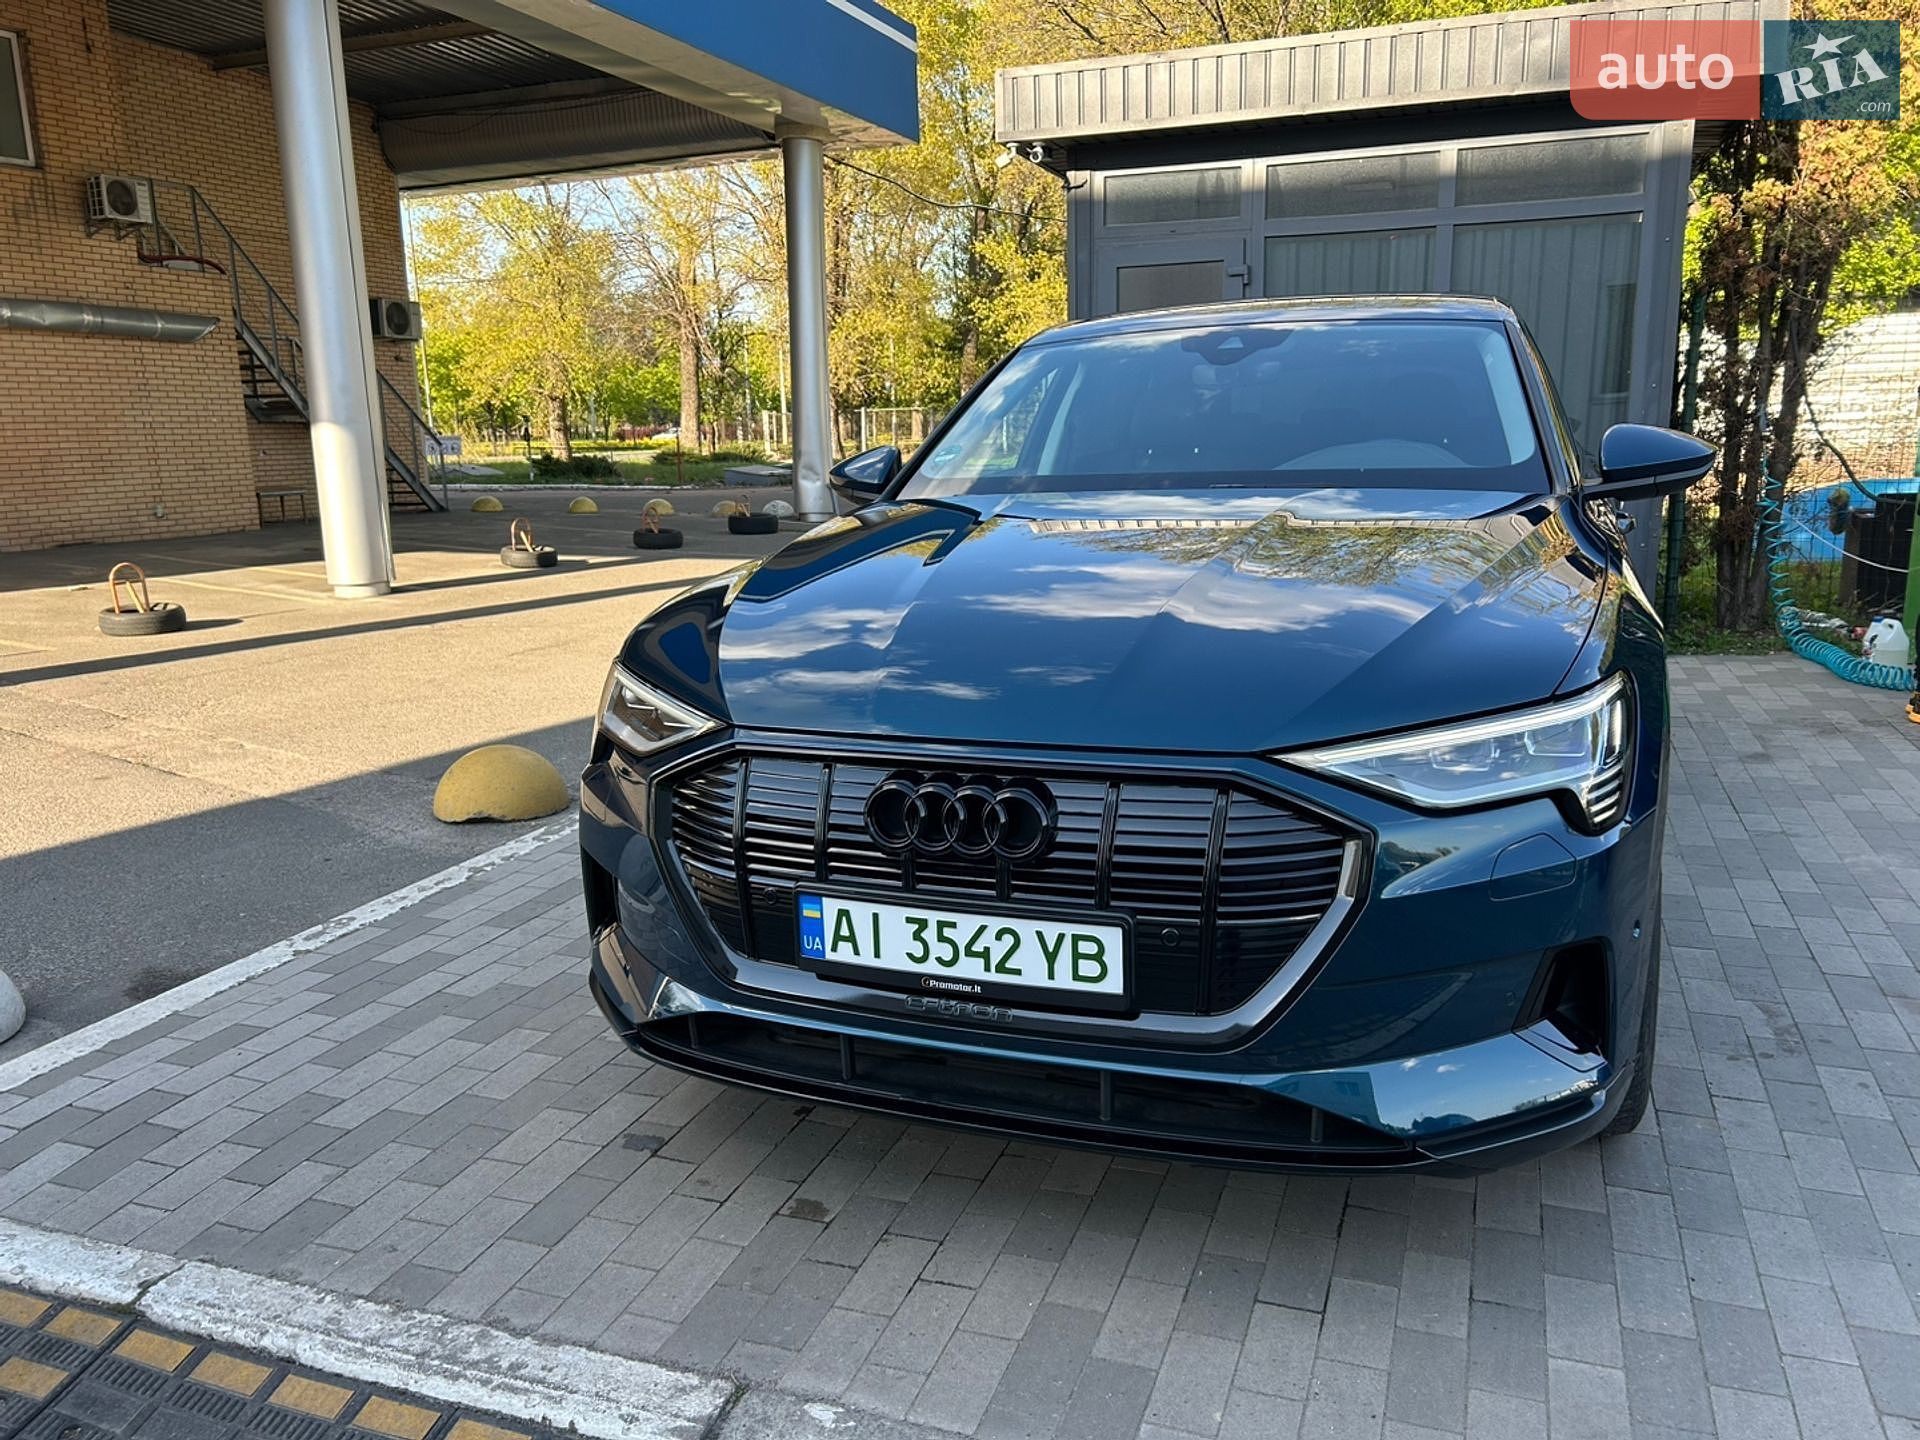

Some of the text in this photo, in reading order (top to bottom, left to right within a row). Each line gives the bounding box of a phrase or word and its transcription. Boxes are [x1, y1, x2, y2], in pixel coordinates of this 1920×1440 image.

[803, 935, 823, 951] UA
[830, 908, 1108, 984] AI 3542 YB
